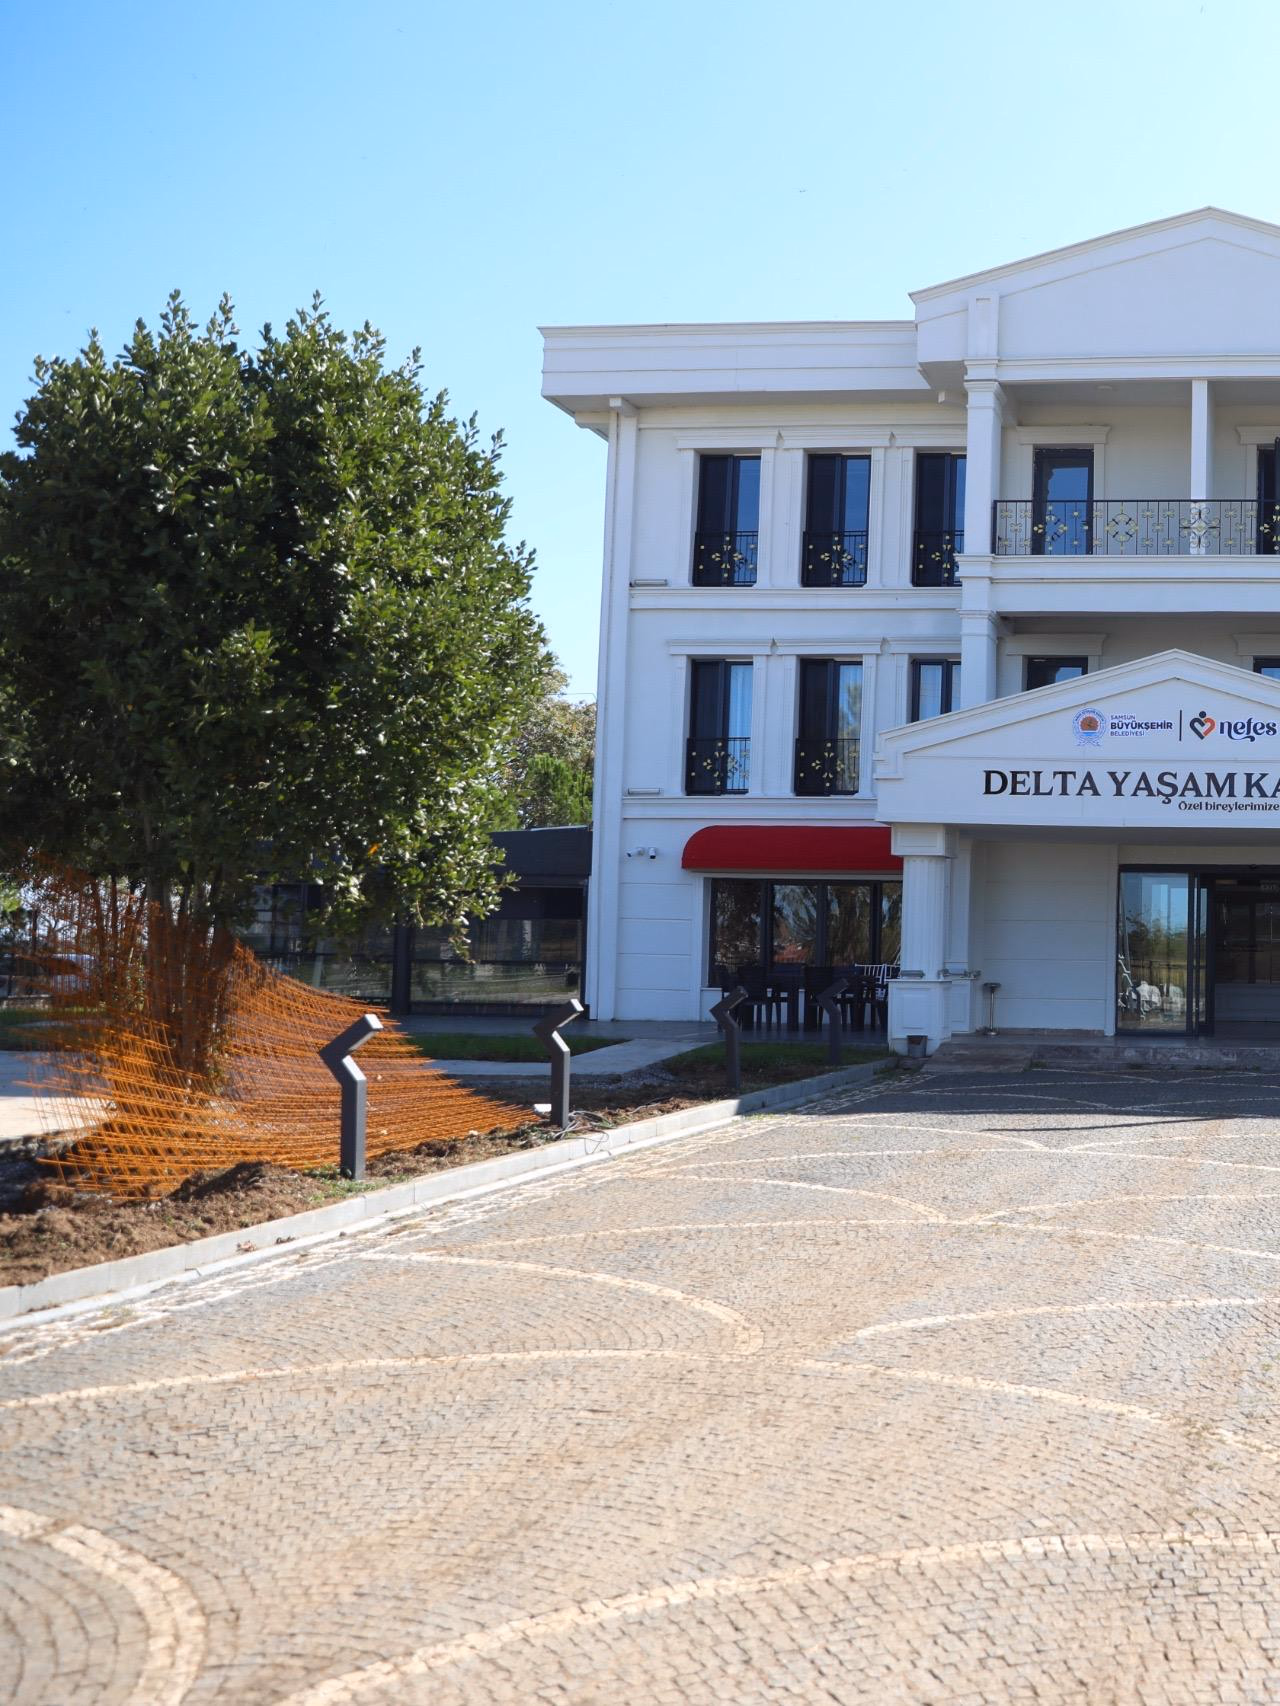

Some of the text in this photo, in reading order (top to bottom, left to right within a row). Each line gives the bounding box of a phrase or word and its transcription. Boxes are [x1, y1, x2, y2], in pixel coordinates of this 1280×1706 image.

[1110, 720, 1173, 730] BÜYÜKŞEHİR
[1219, 717, 1278, 742] nefes
[983, 769, 1102, 796] DELTA
[1106, 771, 1238, 805] YAŞAM
[1178, 800, 1203, 811] Özel
[1205, 801, 1280, 813] bireylerimize
